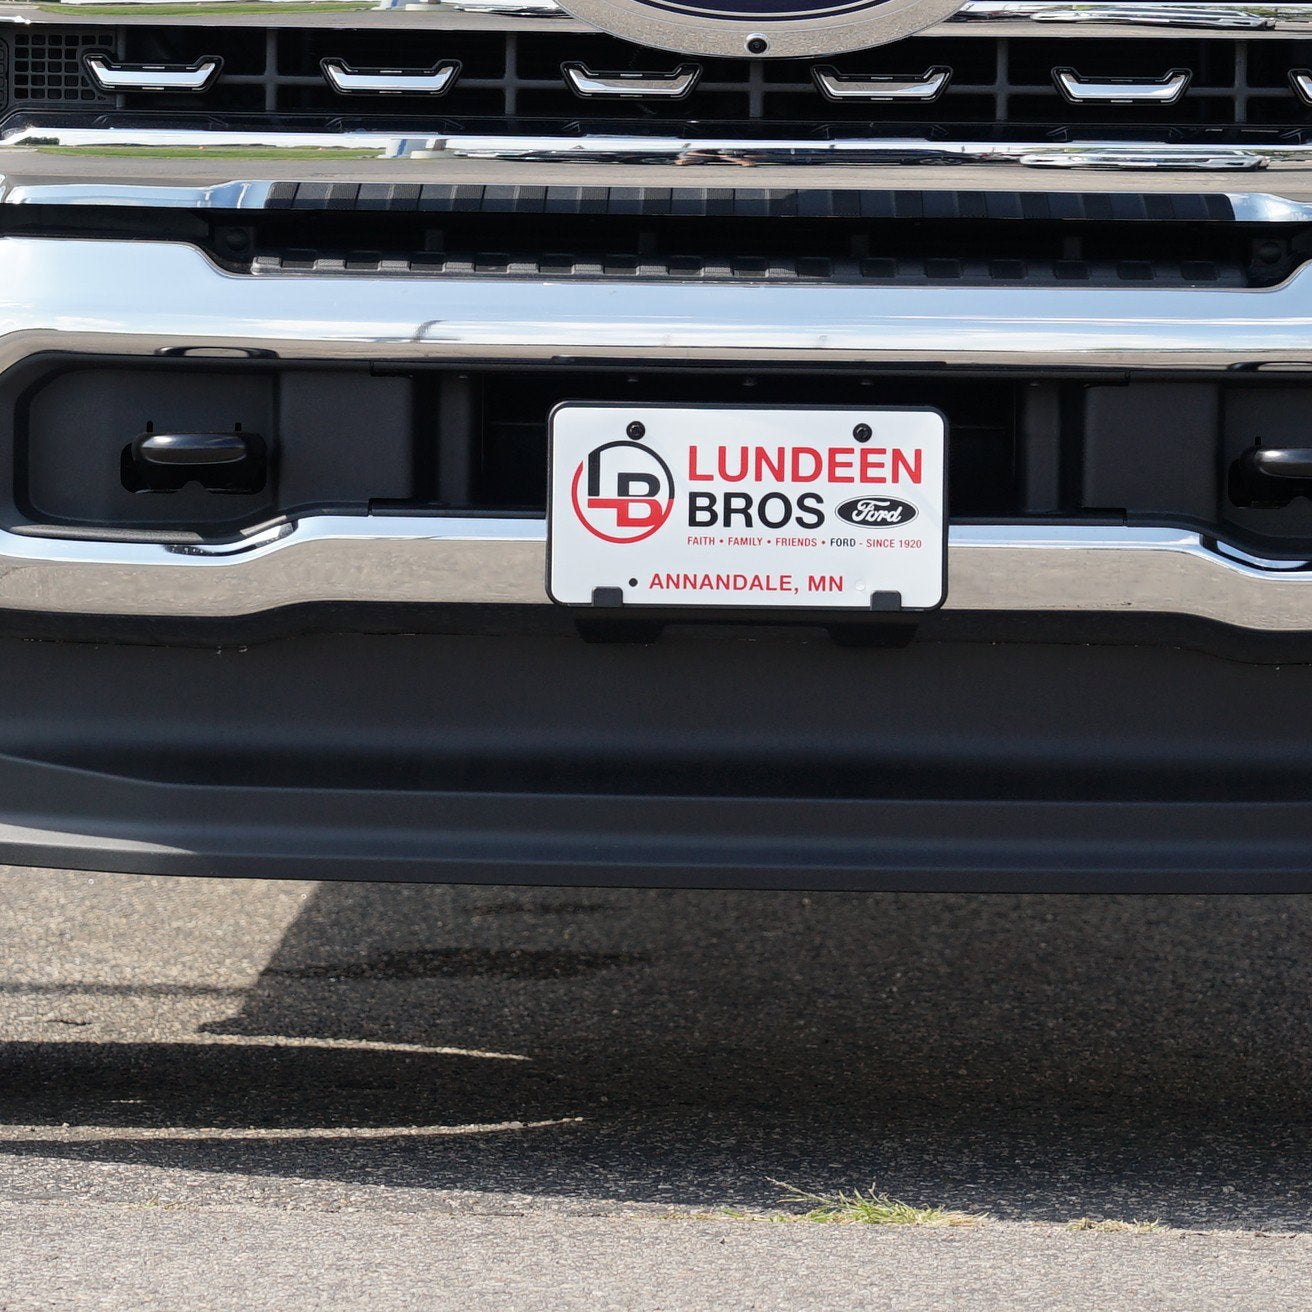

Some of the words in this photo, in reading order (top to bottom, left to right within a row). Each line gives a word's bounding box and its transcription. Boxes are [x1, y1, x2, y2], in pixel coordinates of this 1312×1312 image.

[688, 445, 922, 484] LUNDEEN
[688, 491, 826, 529] BROS
[851, 501, 902, 524] Ford
[687, 535, 716, 547] FAITH
[728, 536, 763, 547] FAMILY
[775, 537, 818, 548] FRIENDS
[830, 537, 856, 548] FORD
[866, 538, 896, 549] SINCE
[899, 538, 923, 549] 1920
[648, 573, 800, 594] ANNANDALE,
[808, 575, 844, 592] MN
